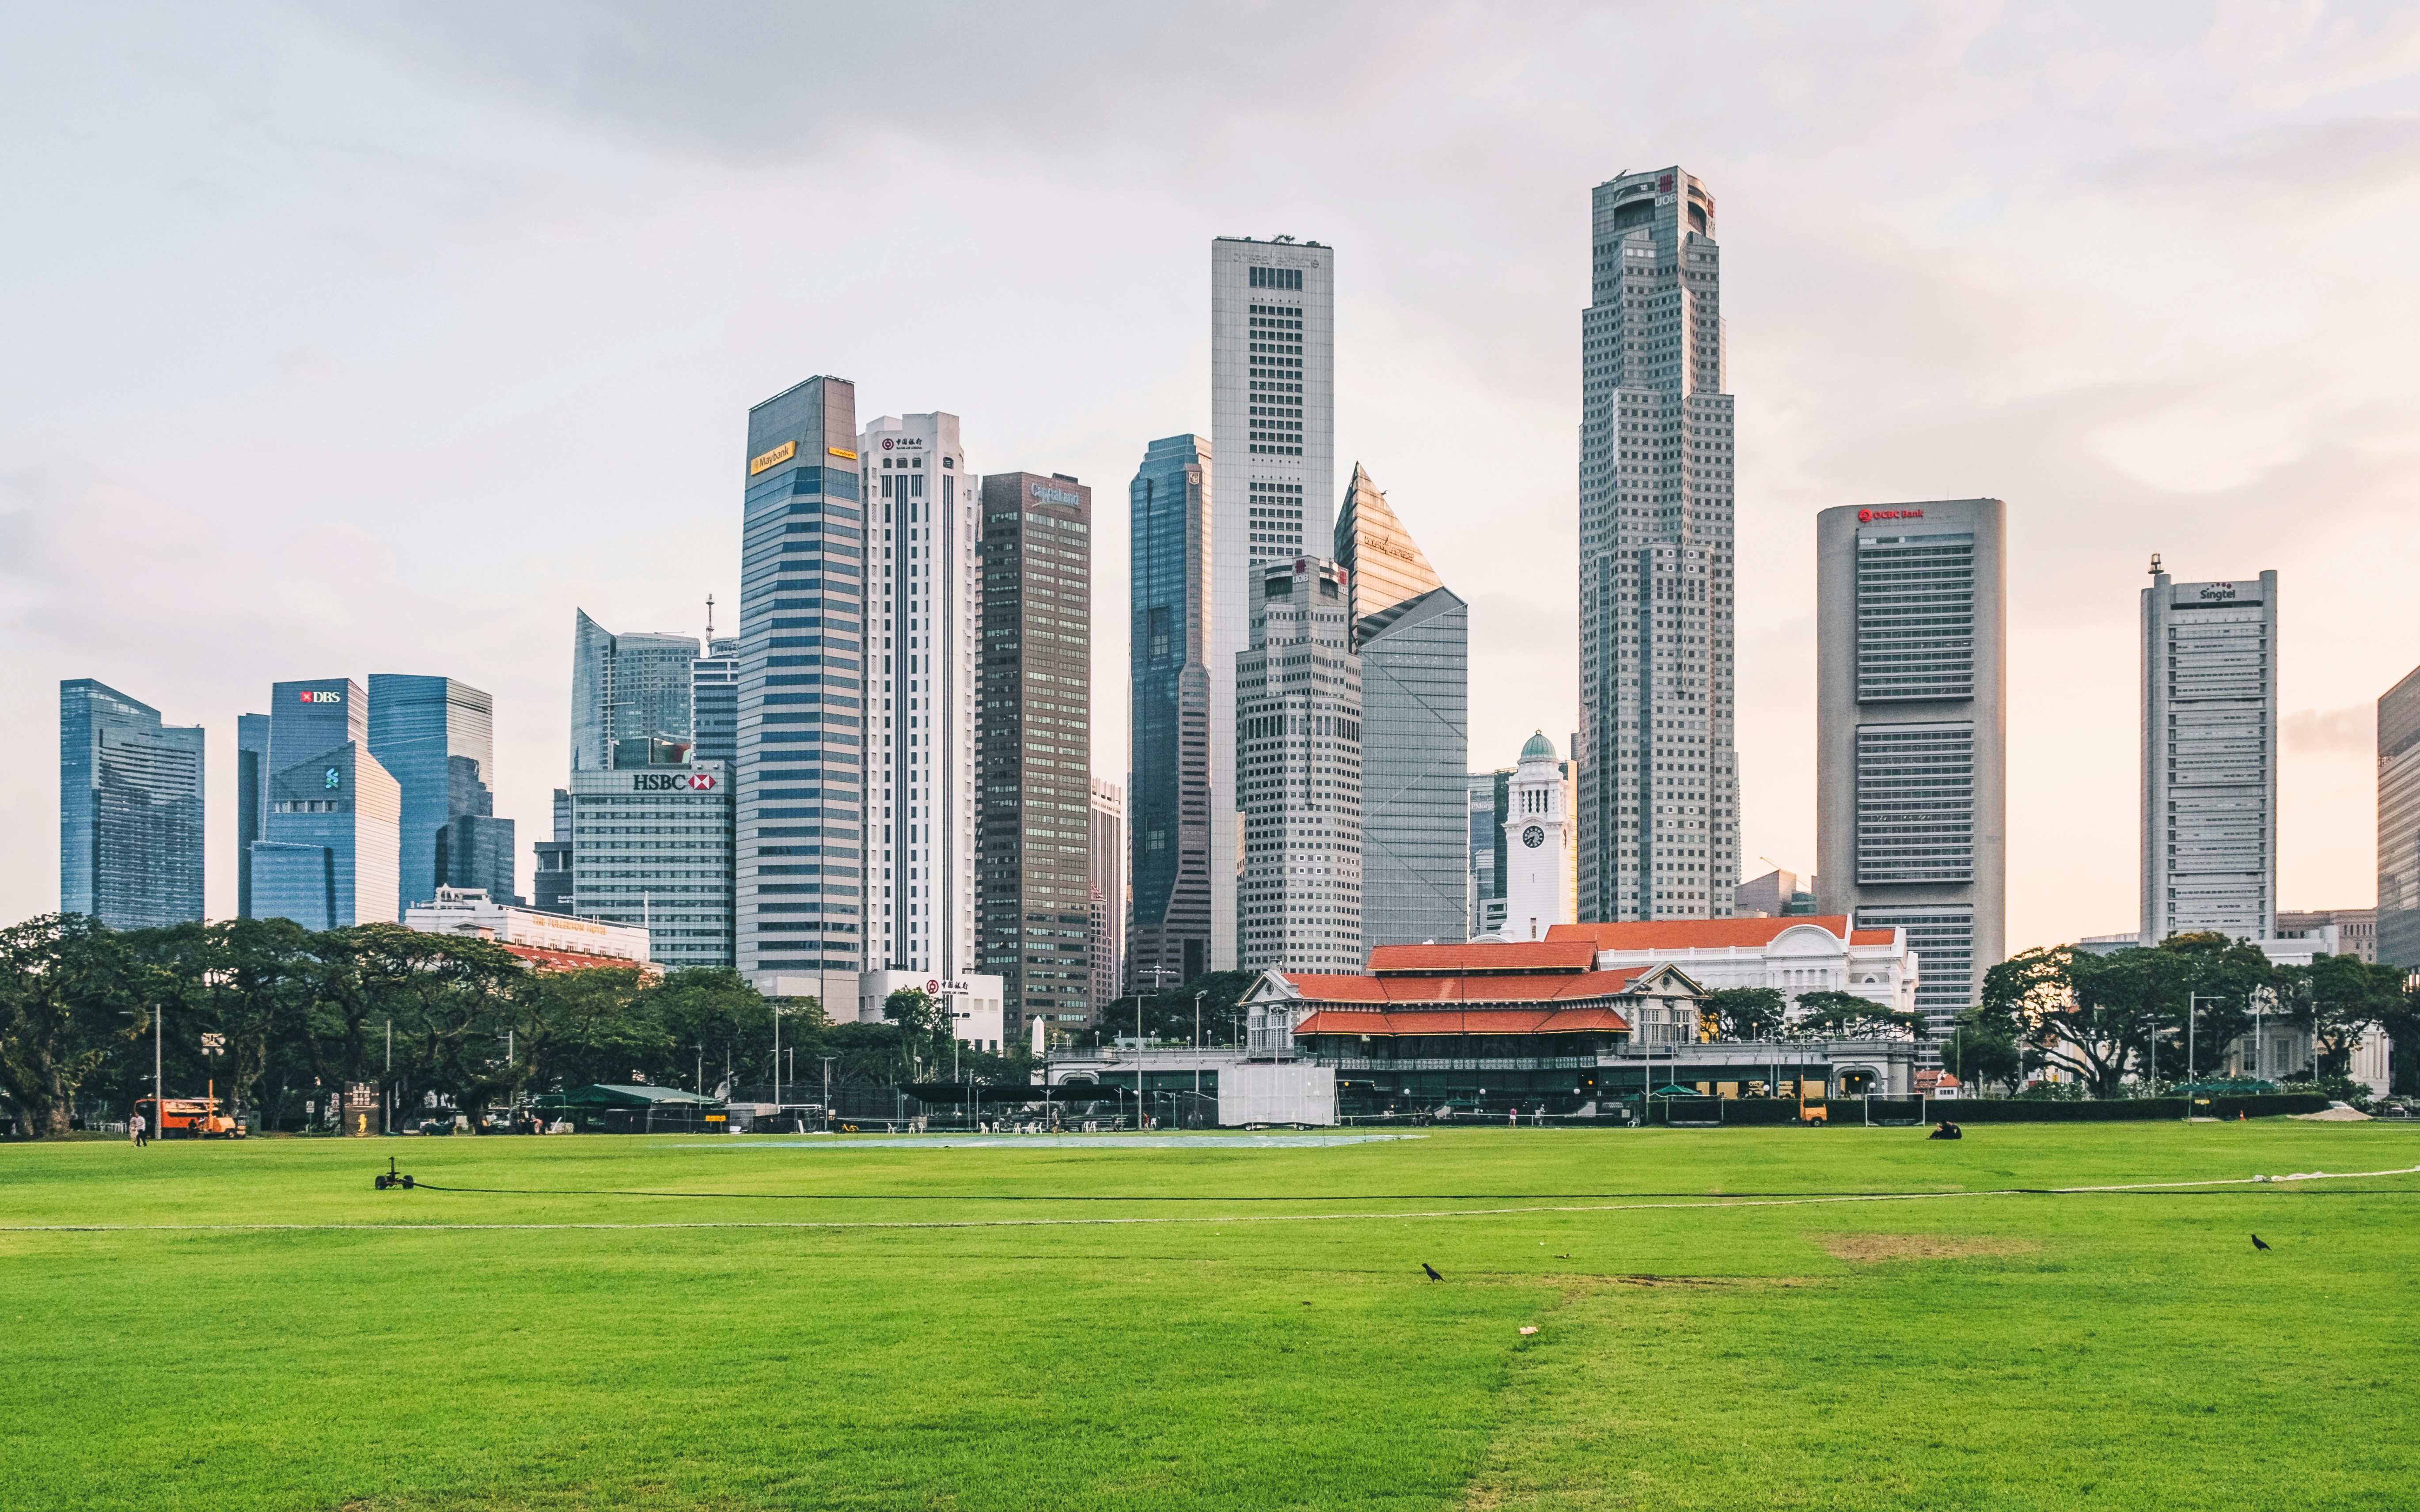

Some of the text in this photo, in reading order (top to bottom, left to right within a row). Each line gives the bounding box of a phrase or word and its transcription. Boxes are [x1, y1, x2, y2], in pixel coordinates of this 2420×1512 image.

[1655, 193, 1677, 207] UOB
[759, 446, 789, 468] Maybank
[834, 449, 855, 458] Maybank
[1031, 482, 1080, 506] CapitaLand
[1873, 508, 1923, 519] OCBC Bank
[1293, 574, 1309, 584] UOB
[2200, 589, 2236, 601] Singtel
[313, 691, 341, 703] DBS
[633, 774, 686, 790] HSBC
